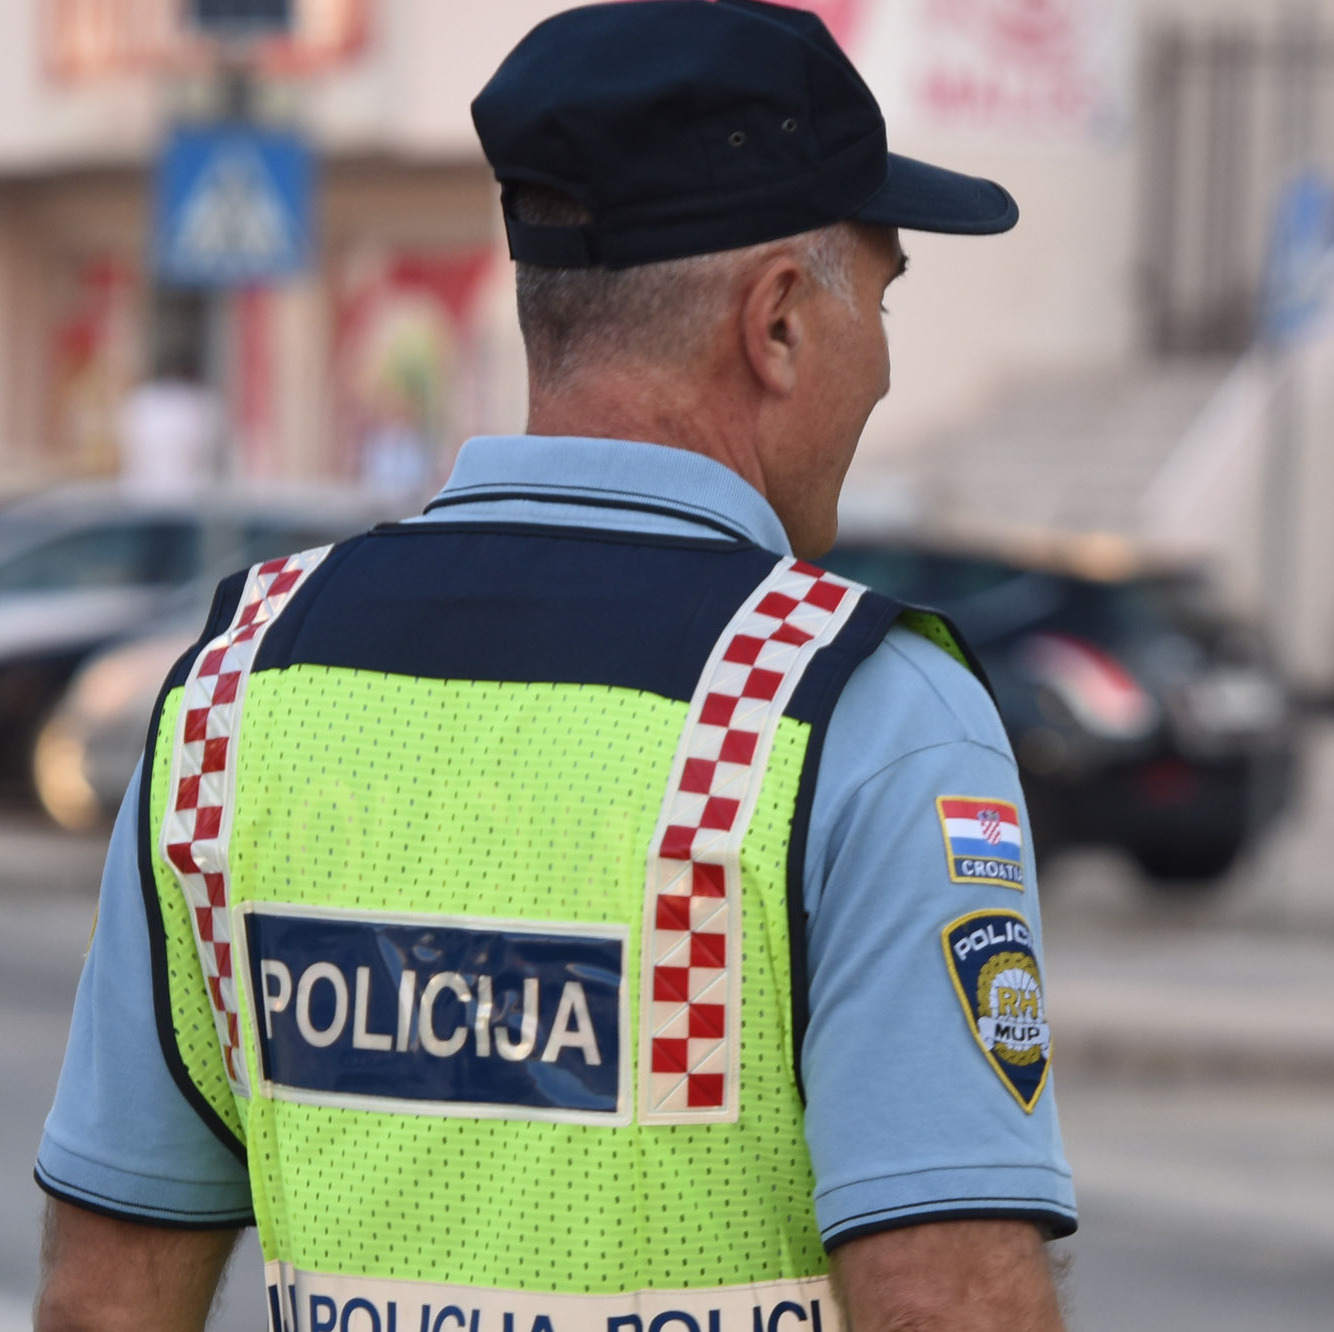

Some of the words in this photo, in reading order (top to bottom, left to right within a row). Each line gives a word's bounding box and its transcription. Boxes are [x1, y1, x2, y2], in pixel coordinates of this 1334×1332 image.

[261, 959, 602, 1066] POLICIJA
[998, 986, 1039, 1019] RH
[994, 1023, 1040, 1041] MUP
